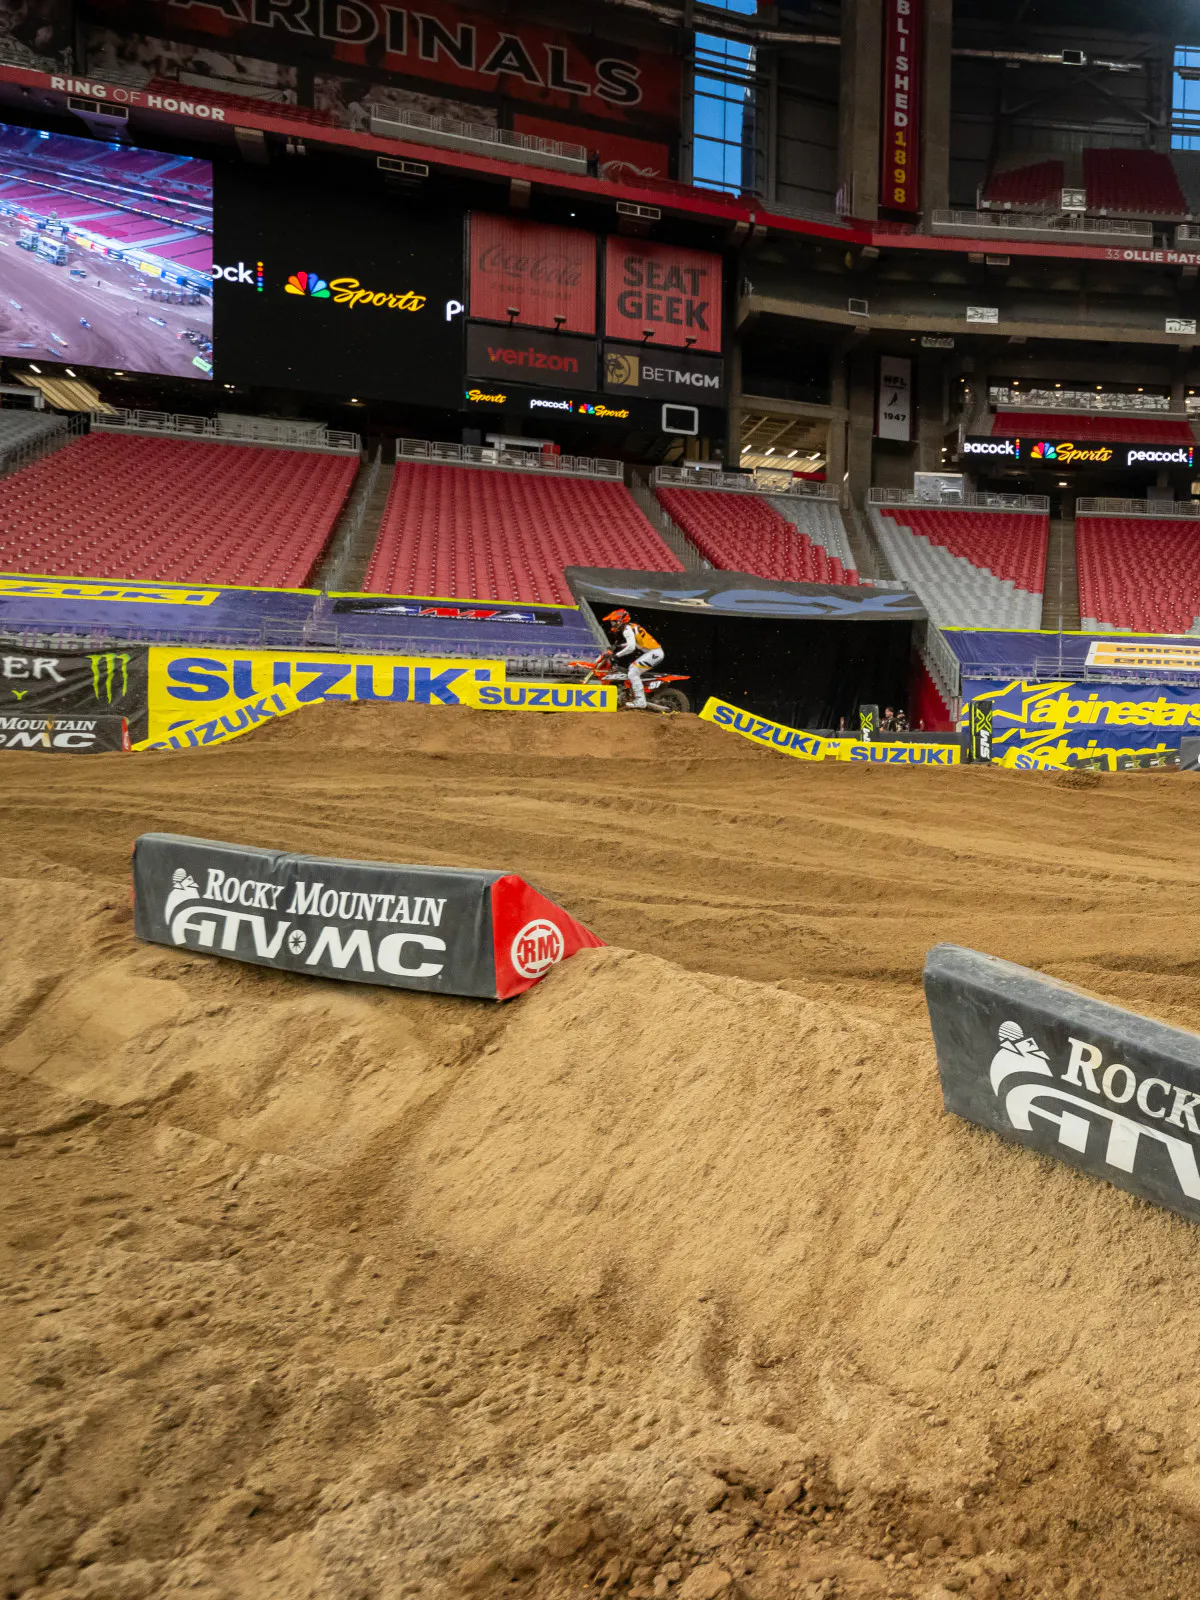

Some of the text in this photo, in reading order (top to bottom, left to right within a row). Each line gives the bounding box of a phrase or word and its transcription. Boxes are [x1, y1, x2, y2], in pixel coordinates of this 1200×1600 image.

[51, 75, 226, 122] RING OF HONOR
[893, 131, 907, 204] 1898
[1105, 249, 1120, 260] 33
[1123, 250, 1164, 262] OLLIE
[623, 255, 707, 297] SEAT
[330, 277, 427, 312] Sports
[617, 289, 710, 332] GEEK
[487, 346, 579, 373] verizon
[642, 366, 720, 389] BETMGM
[468, 389, 507, 403] Sports
[530, 398, 569, 410] peacock
[594, 405, 629, 419] Sports
[883, 411, 906, 421] 1947
[1056, 442, 1113, 464] Sports
[1127, 447, 1188, 465] peacock
[478, 686, 608, 708] SUZUKI
[0, 717, 97, 731] MOUNTAIN
[713, 705, 822, 756] SUZUKI
[850, 746, 953, 764] SUZUKI
[203, 868, 447, 927] ROCKY MOUNTAIN
